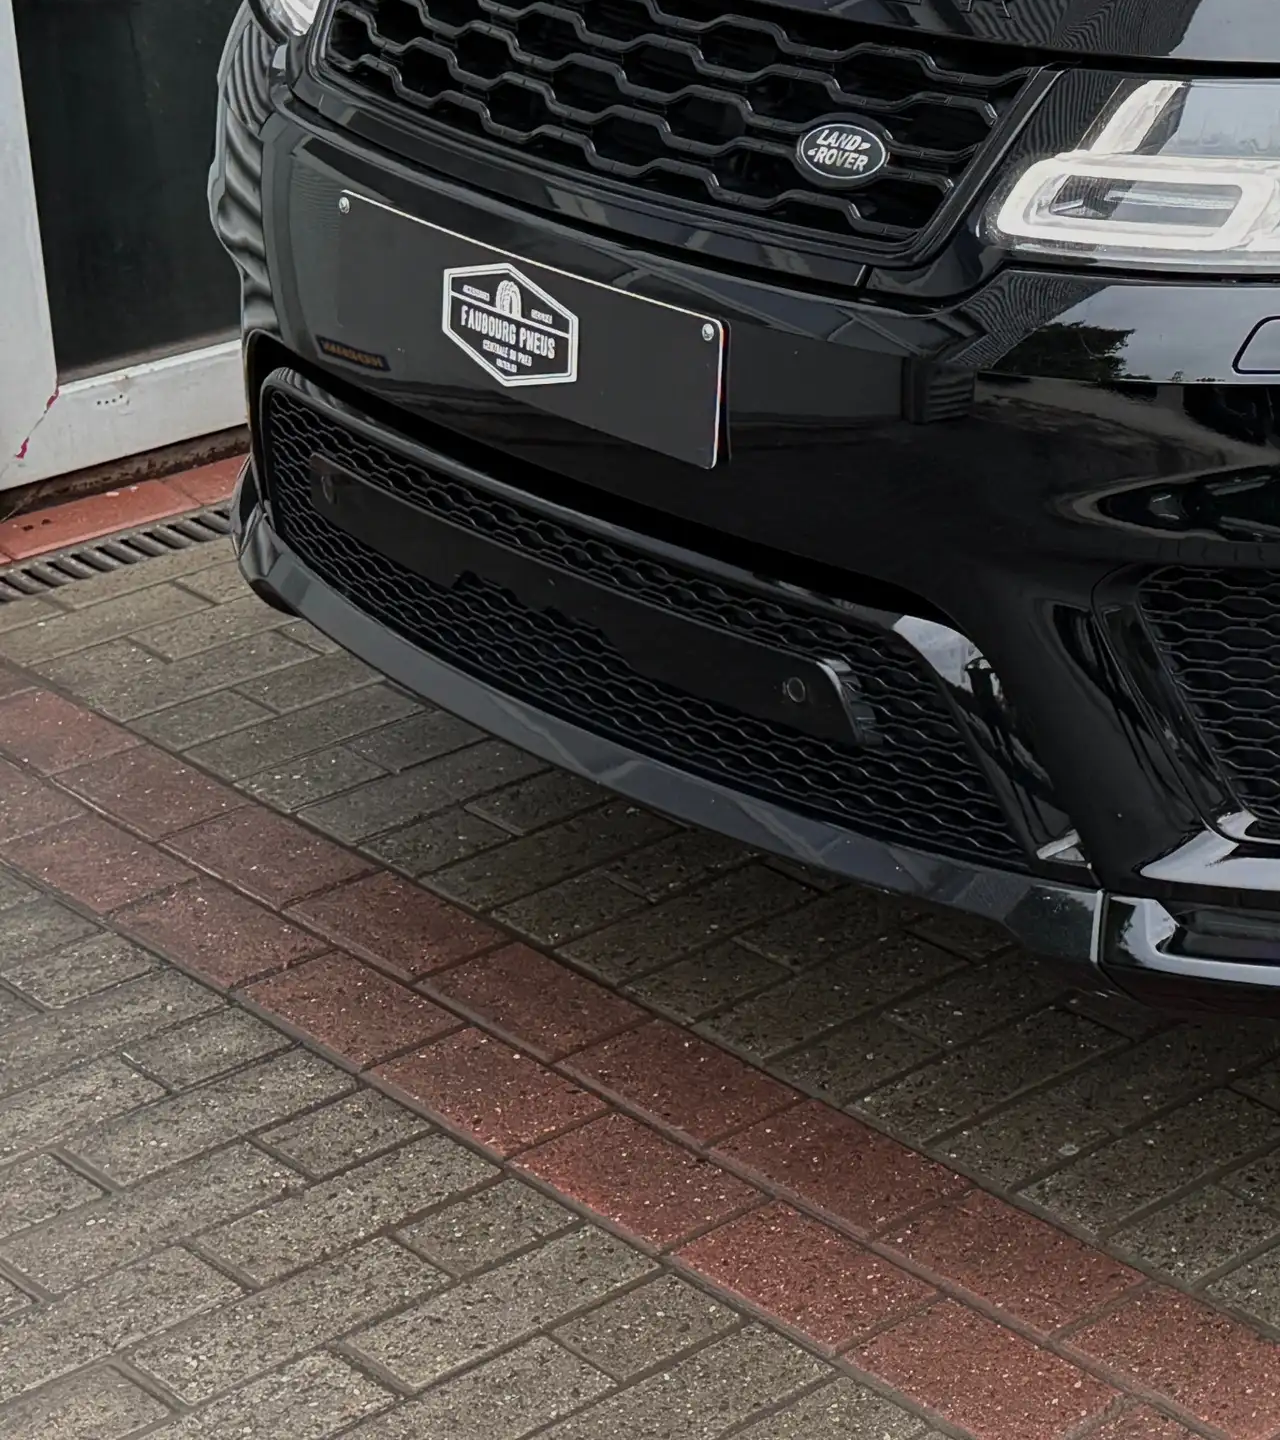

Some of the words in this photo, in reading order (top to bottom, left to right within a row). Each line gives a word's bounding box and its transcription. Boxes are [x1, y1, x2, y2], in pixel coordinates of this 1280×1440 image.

[816, 129, 862, 151] LAND
[813, 146, 869, 172] ROVER
[460, 305, 517, 345] FAUBOURG
[519, 326, 556, 359] PNEUS
